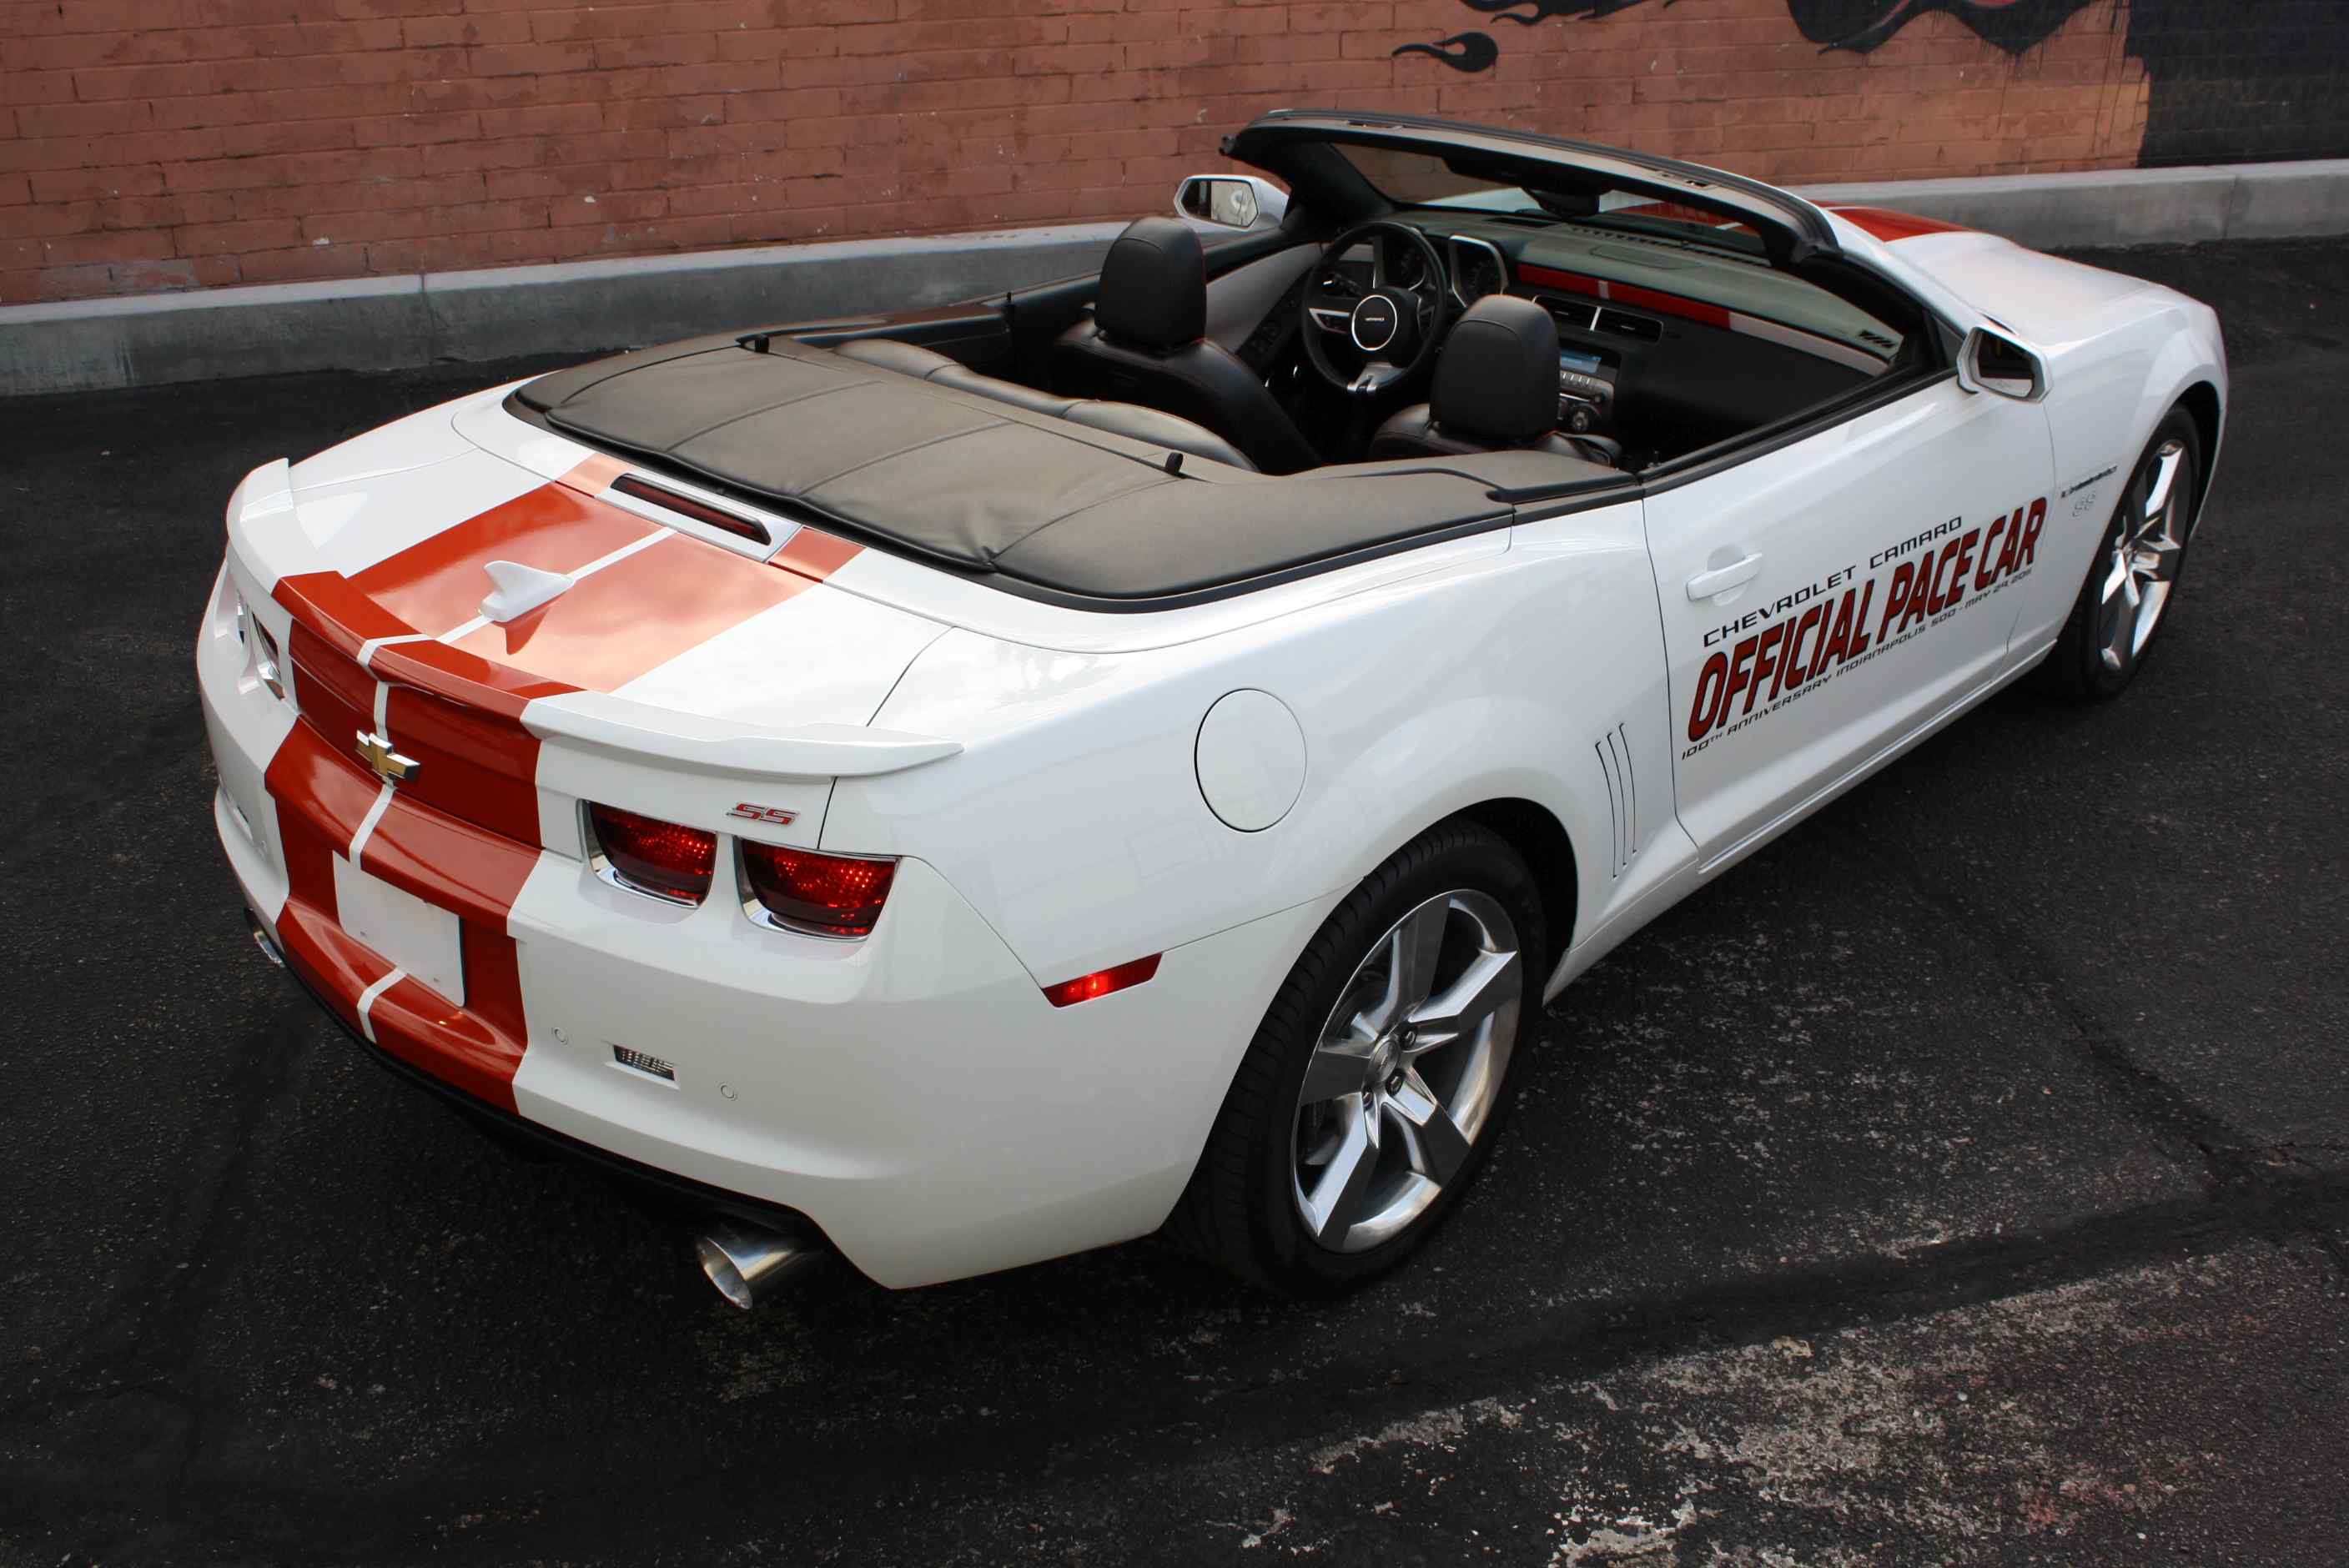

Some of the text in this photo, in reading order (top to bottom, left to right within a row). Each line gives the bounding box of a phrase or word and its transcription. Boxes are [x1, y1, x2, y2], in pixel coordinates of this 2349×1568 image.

[1688, 496, 2048, 742] OFFICIAL PACE CAR
[1703, 515, 1962, 648] CHEVROLET CAMARO
[1727, 673, 1832, 736] ANNIVERSARY
[1836, 626, 1926, 677] INDIANAPOLIS
[1930, 607, 1956, 627] 500
[725, 802, 799, 825] SS
